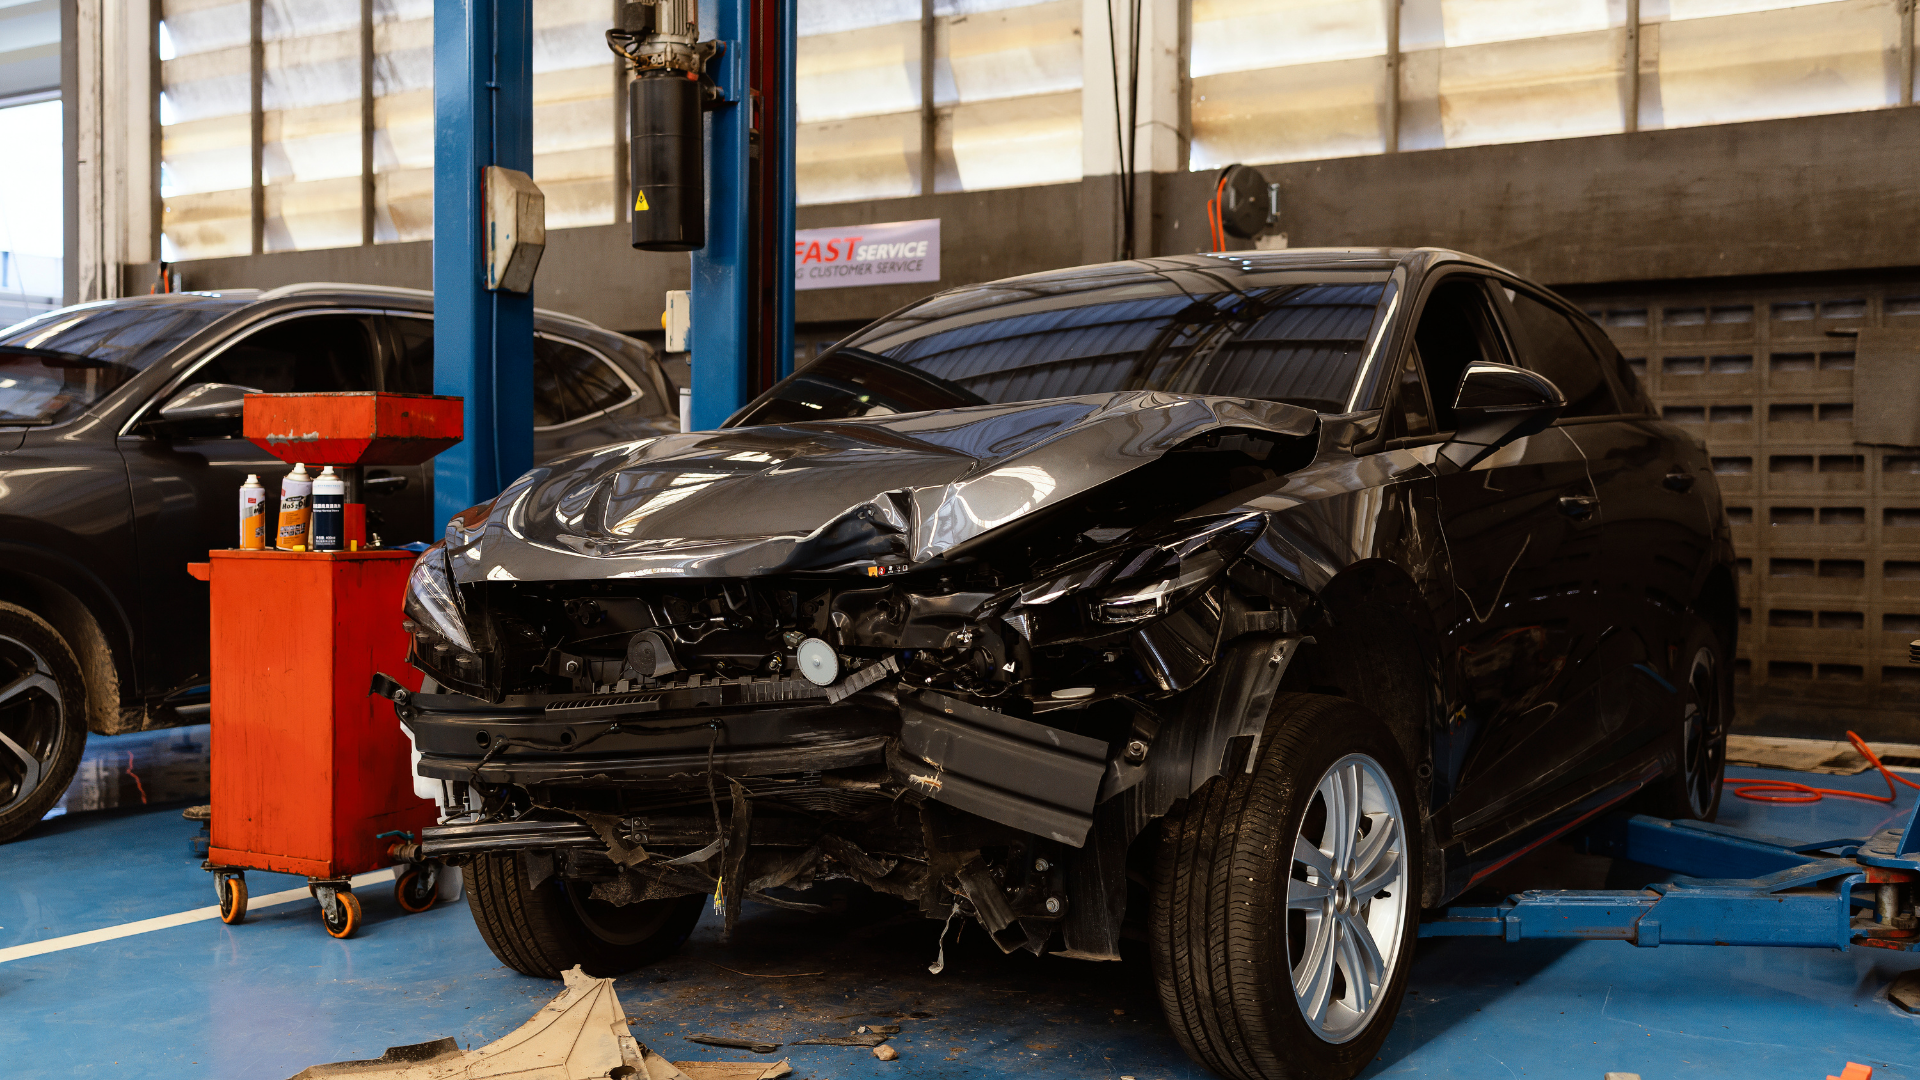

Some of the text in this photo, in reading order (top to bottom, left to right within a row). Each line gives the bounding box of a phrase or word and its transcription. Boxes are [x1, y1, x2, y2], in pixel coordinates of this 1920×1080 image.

[856, 240, 929, 262] SERVICE
[809, 262, 873, 278] CUSTOMER
[876, 259, 924, 274] SERVICE
